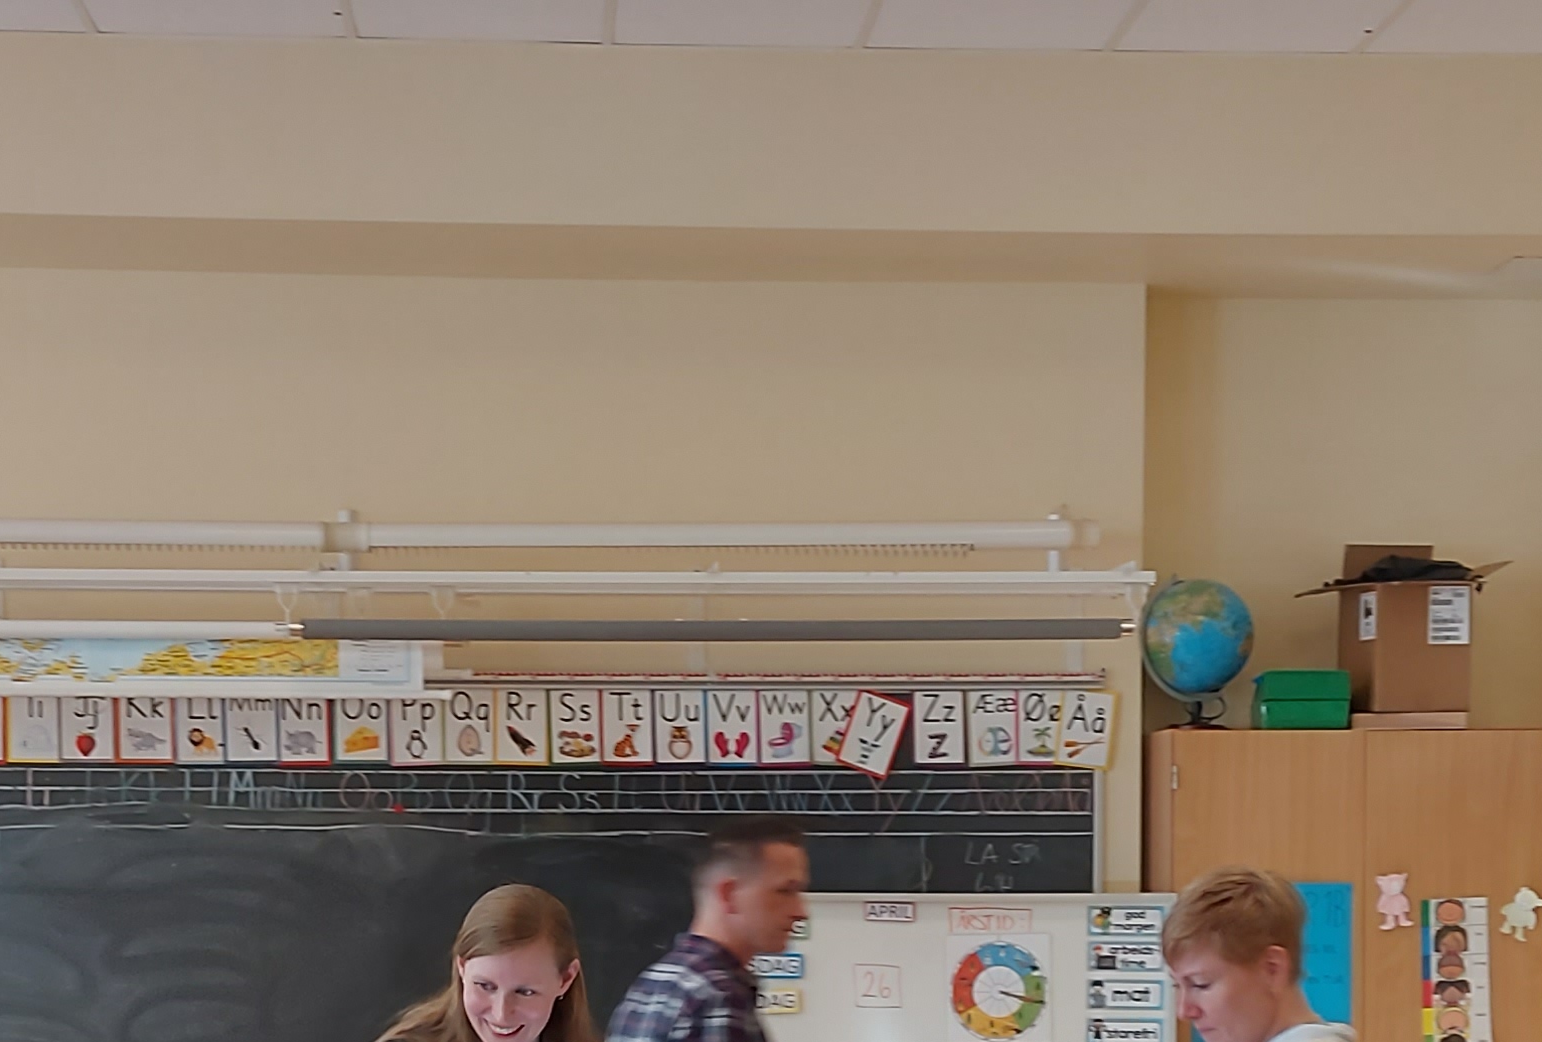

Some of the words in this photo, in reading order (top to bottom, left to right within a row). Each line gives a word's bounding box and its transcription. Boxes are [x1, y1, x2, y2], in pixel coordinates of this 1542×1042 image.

[126, 698, 165, 718] Kk
[228, 698, 273, 711] Mm
[281, 698, 323, 720] Nn
[341, 698, 383, 720] Oo
[401, 698, 437, 733] Pp
[450, 691, 491, 732] Qq
[506, 691, 538, 721] Rr
[559, 692, 593, 722] Ss
[608, 692, 645, 721] Tt
[661, 693, 700, 722] Uu
[712, 693, 751, 722] Vv
[763, 694, 805, 715] Ww
[818, 692, 855, 722] Xx
[865, 697, 897, 742] Yy
[922, 693, 957, 722] Zz
[972, 693, 1017, 714] Ææ
[1066, 694, 1107, 734] Åå
[867, 904, 912, 919] APRIL
[1125, 912, 1147, 920] god
[861, 971, 892, 999] 26
[756, 992, 797, 1009] DAG
[1111, 987, 1151, 1002] mat
